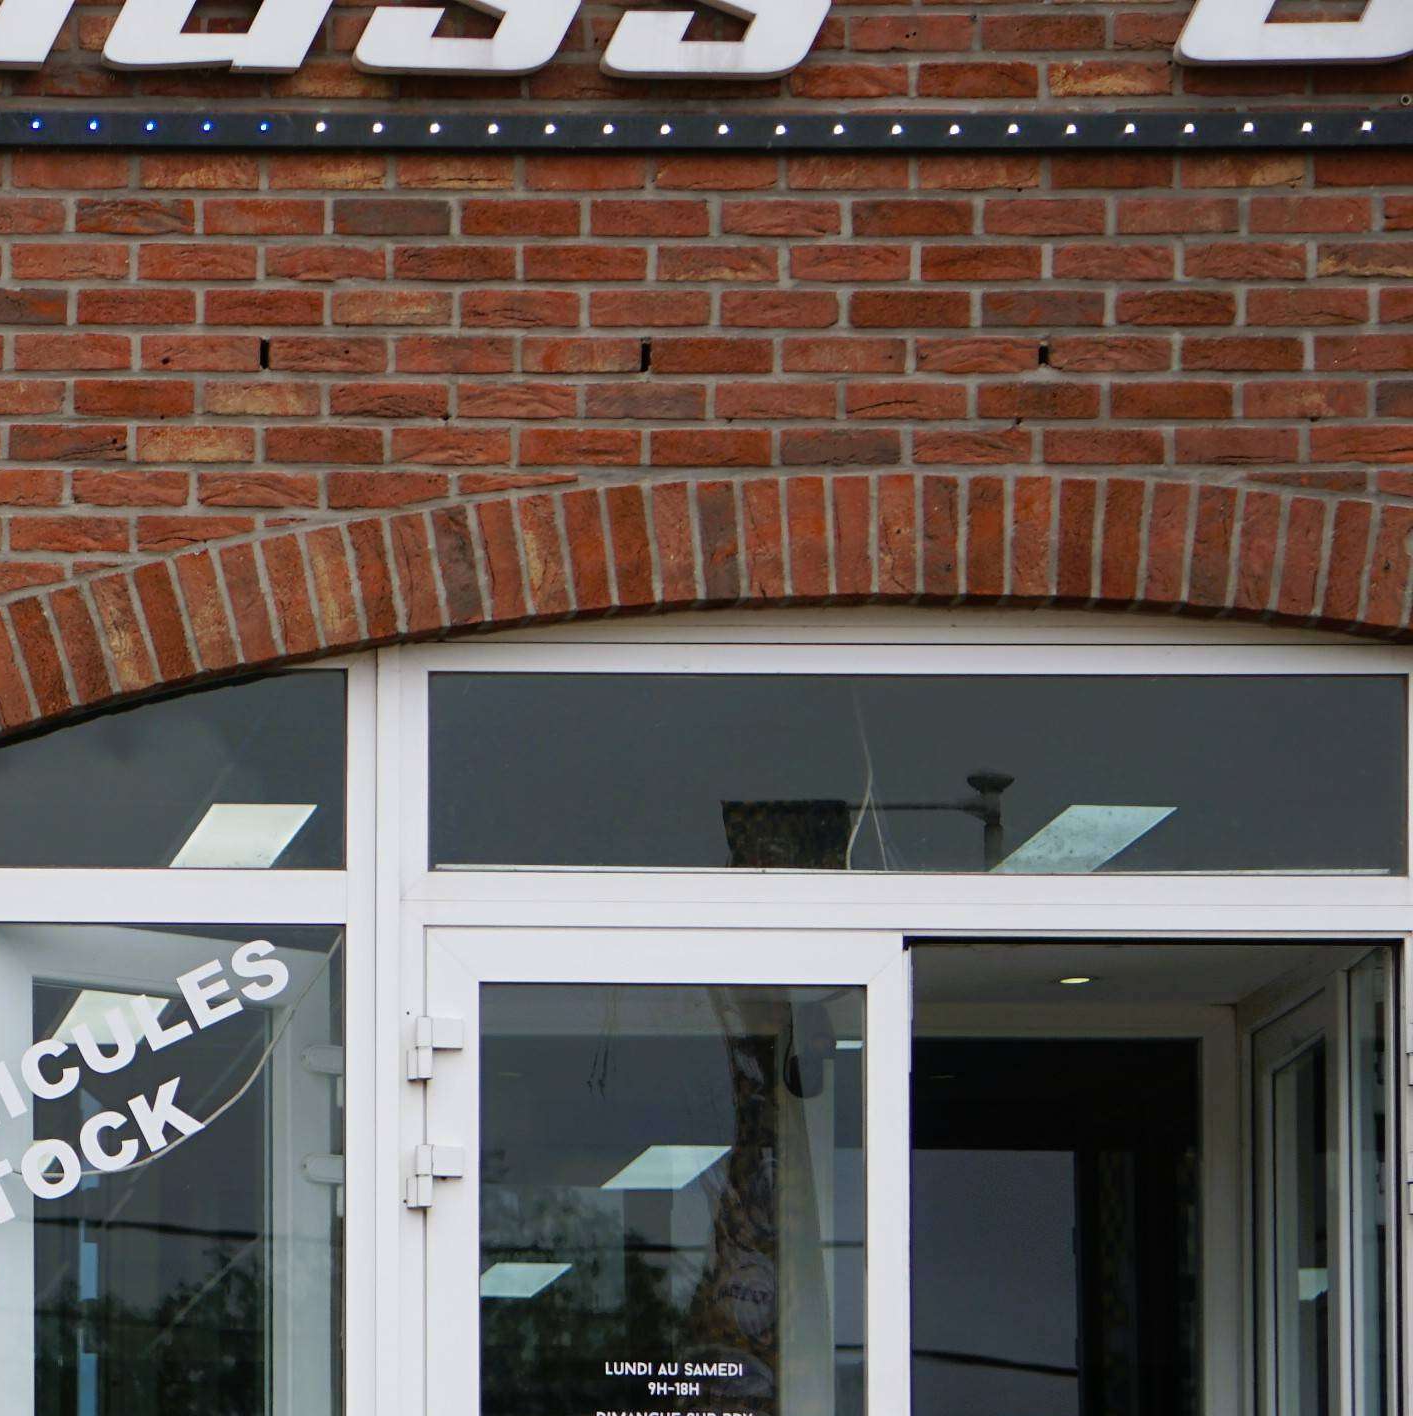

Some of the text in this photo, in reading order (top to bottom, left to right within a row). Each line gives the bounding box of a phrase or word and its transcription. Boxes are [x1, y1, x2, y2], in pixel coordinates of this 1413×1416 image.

[605, 1361, 743, 1377] LUNDI AU SAMEDI
[647, 1382, 700, 1396] 9H-18H
